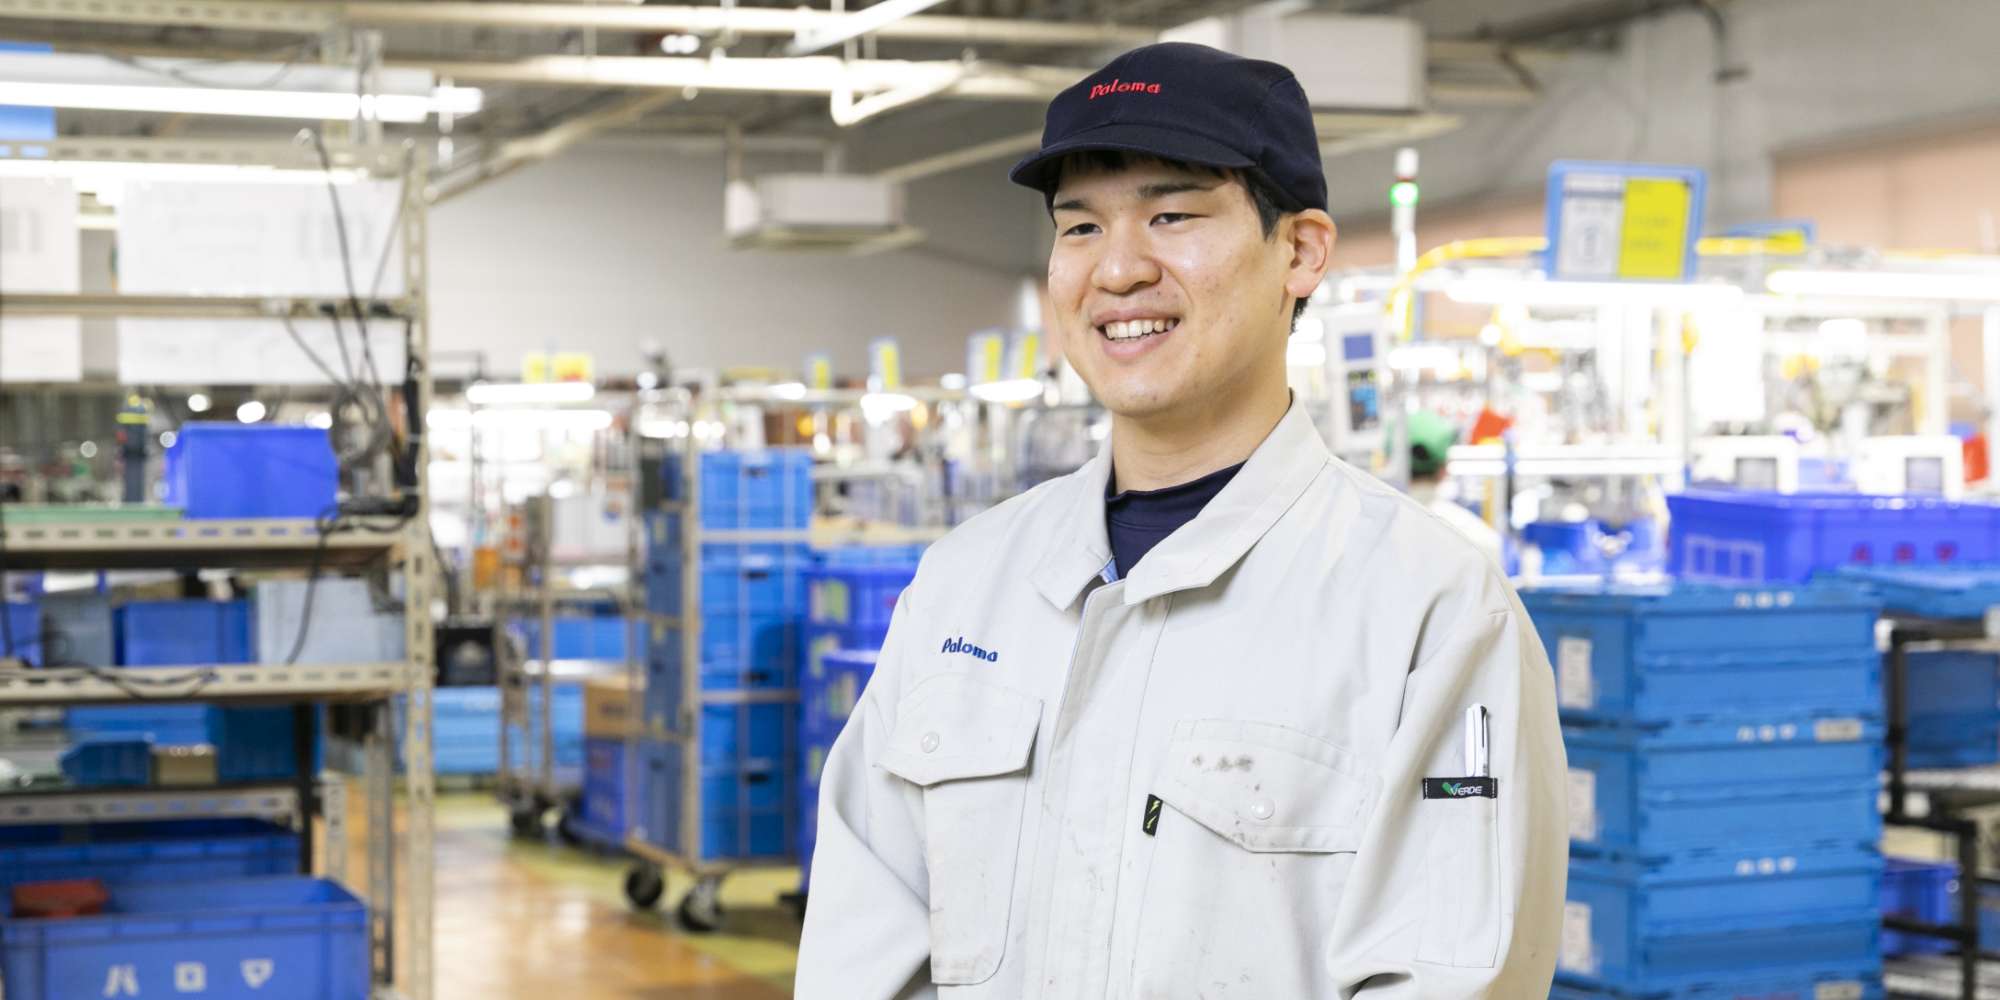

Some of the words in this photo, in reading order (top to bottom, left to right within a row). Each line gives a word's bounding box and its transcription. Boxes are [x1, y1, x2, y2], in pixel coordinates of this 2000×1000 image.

[1089, 79, 1162, 100] Paloma
[941, 636, 998, 662] Paloma
[1446, 783, 1483, 796] VERDE
